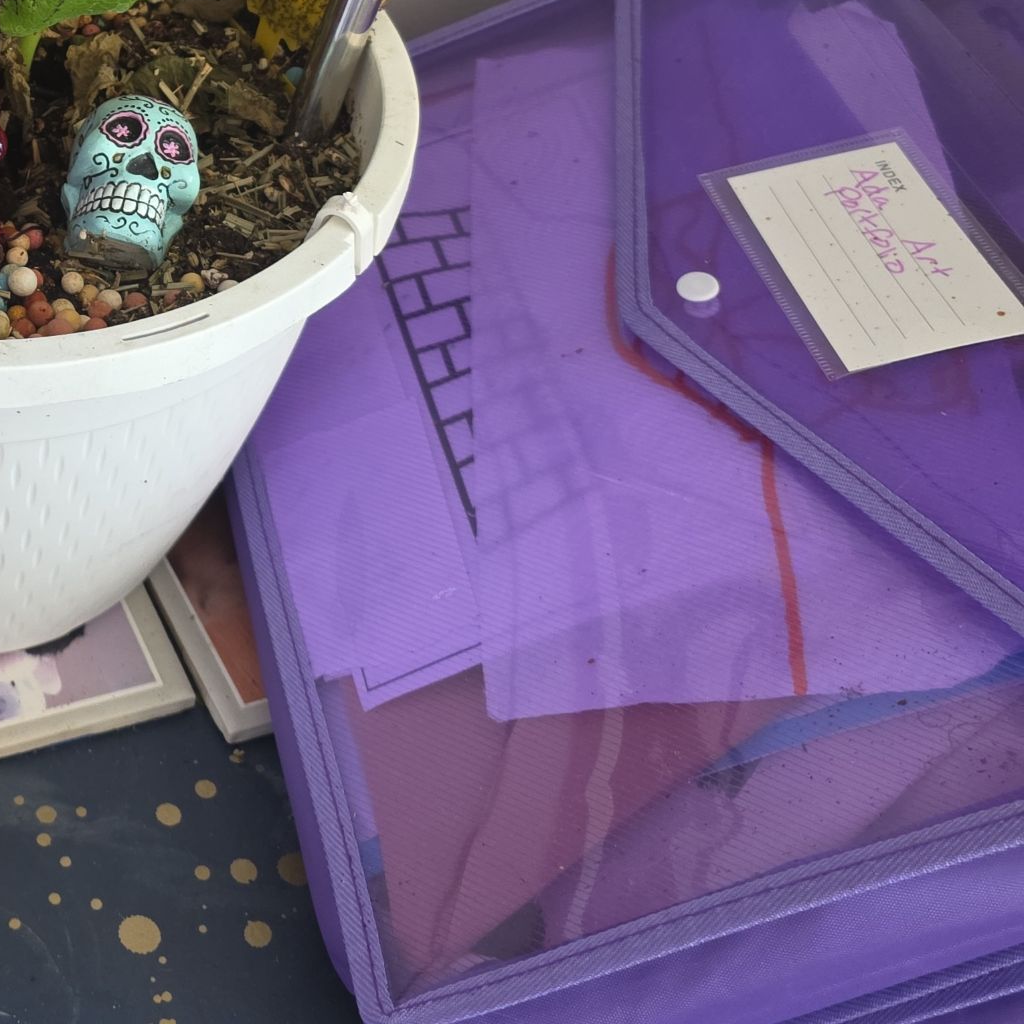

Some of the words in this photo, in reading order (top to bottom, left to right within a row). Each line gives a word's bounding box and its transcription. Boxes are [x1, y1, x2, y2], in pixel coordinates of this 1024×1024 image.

[875, 160, 907, 193] INDEX
[849, 169, 889, 211] Ada
[901, 239, 953, 277] Art
